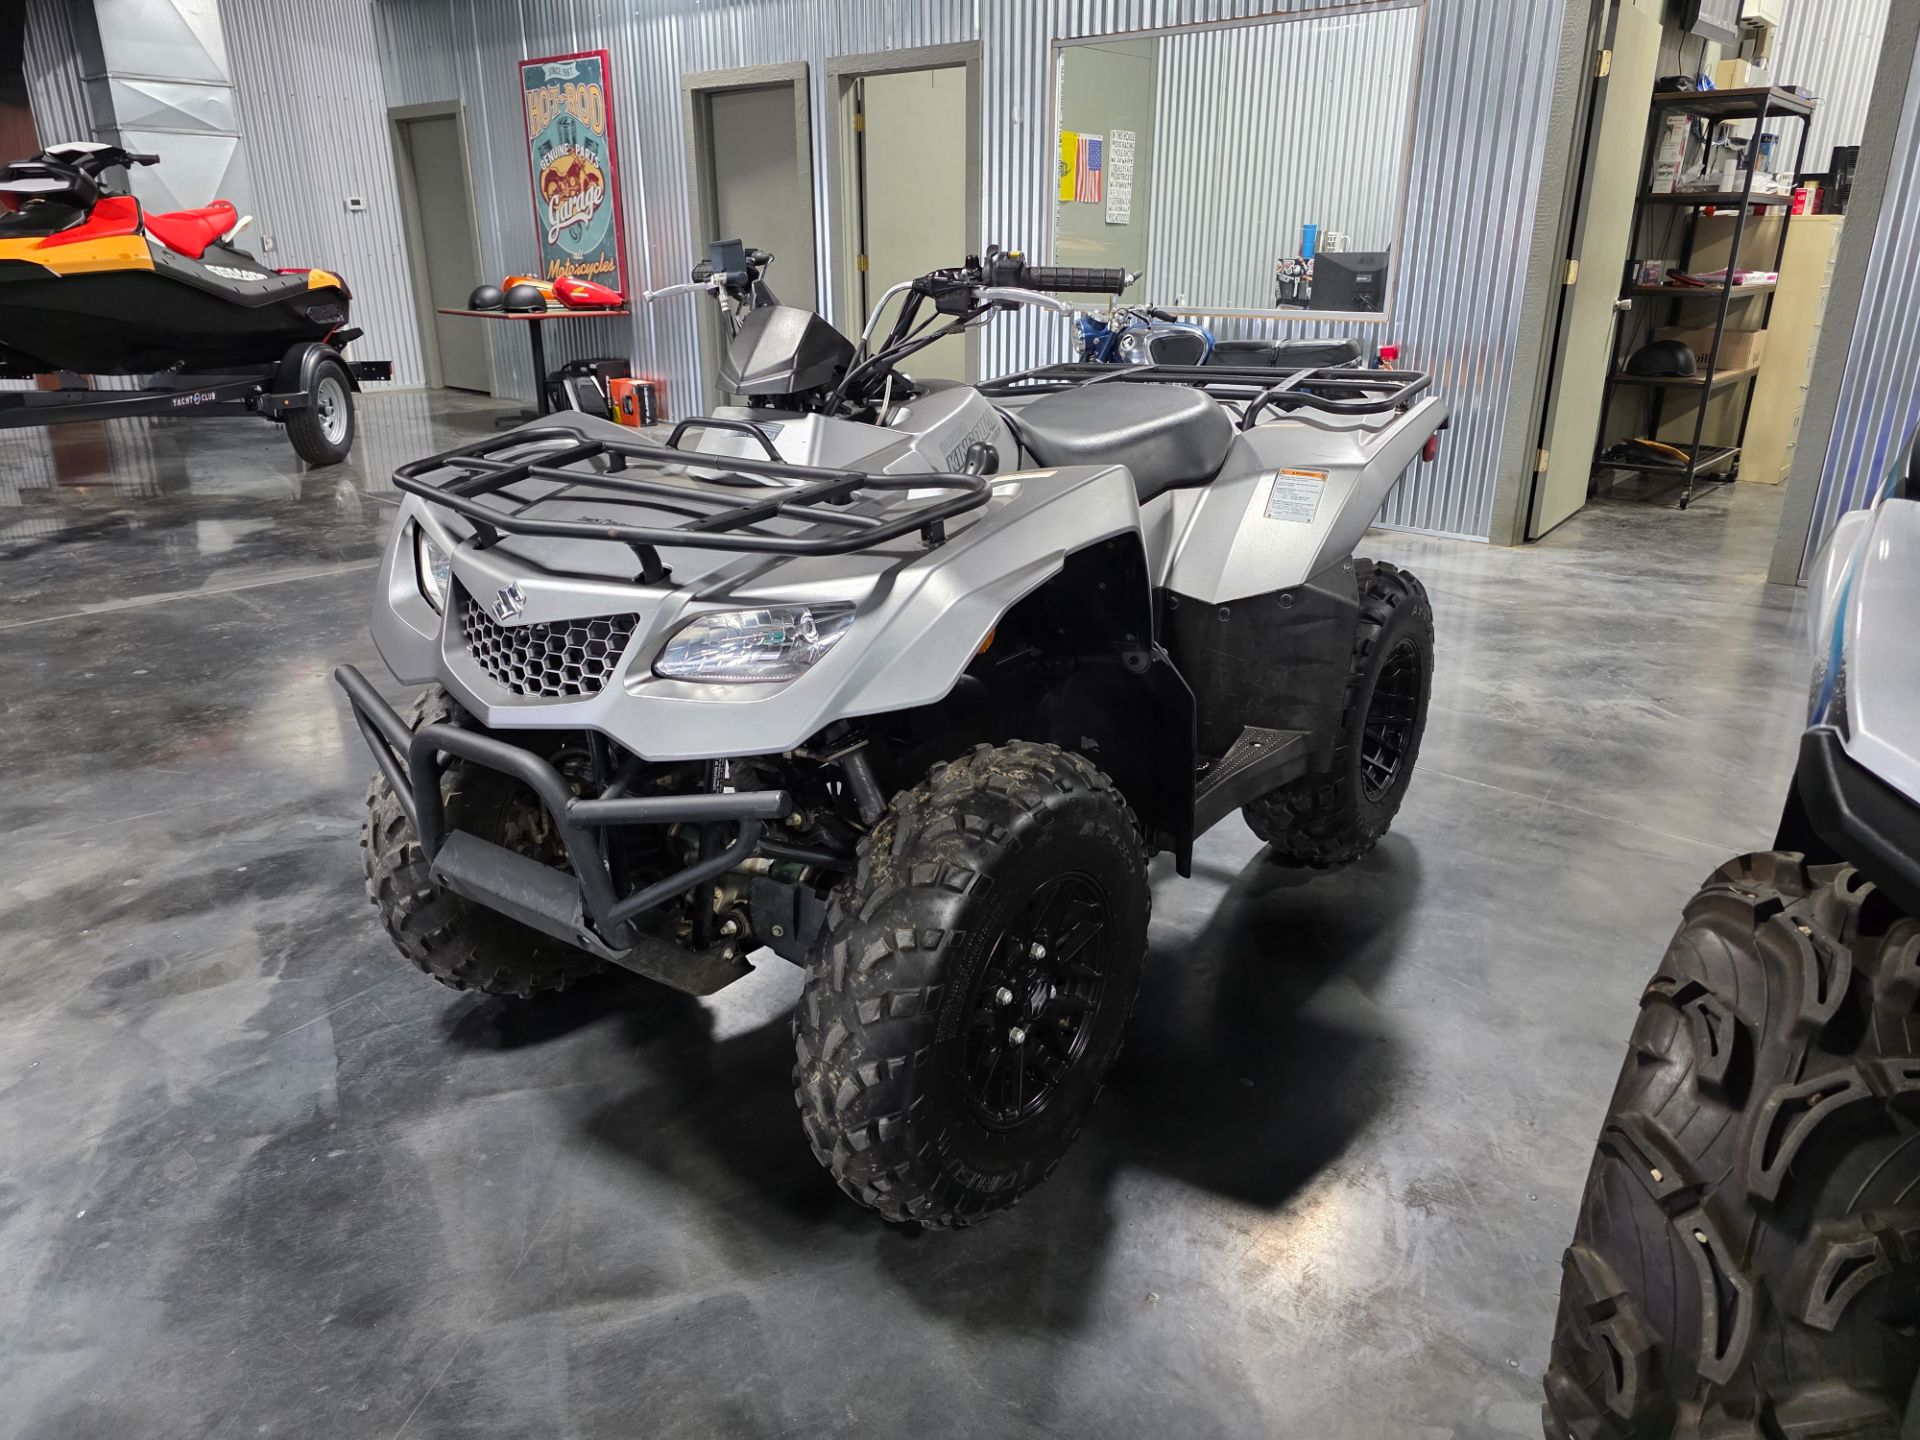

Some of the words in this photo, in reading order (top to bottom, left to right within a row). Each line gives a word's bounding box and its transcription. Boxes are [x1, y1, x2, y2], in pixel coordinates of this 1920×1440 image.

[540, 143, 569, 171] GENUINE
[575, 143, 600, 168] PARTS
[547, 185, 604, 244] Garage
[547, 250, 616, 281] Motorcycles
[172, 395, 193, 407] YACHT
[201, 391, 216, 401] CLUB
